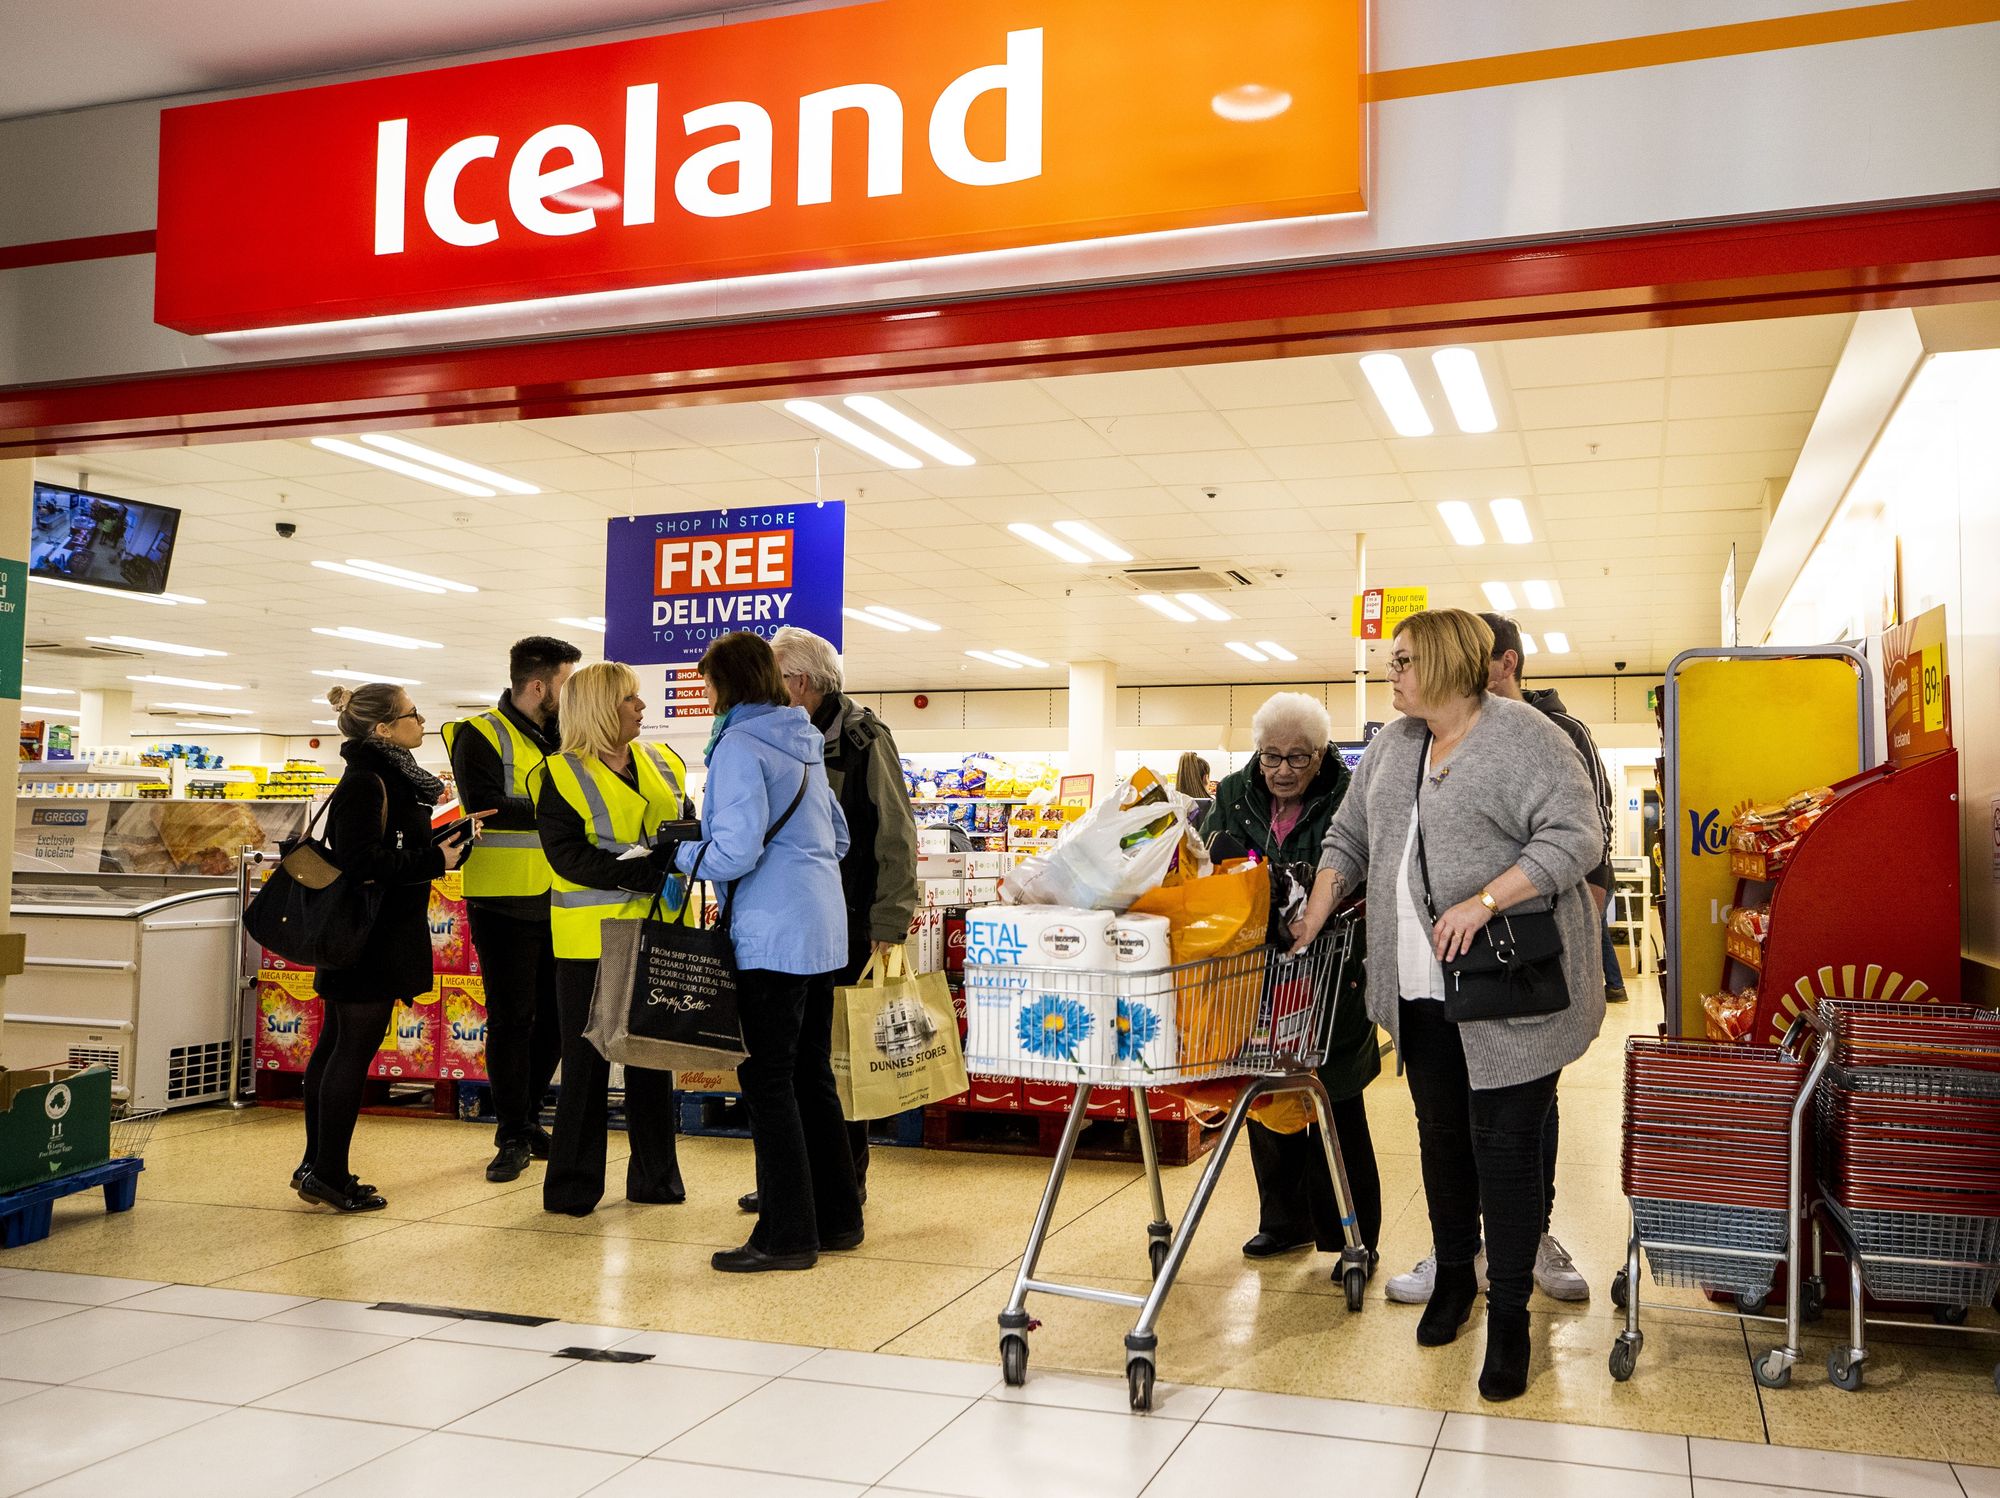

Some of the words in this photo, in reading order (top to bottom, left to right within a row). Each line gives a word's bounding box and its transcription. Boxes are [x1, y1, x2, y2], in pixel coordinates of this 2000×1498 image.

[374, 26, 1044, 256] Iceland
[655, 519, 702, 533] SHOP
[711, 517, 729, 529] IN
[739, 512, 795, 527] STORE
[661, 535, 786, 589] FREE
[1386, 594, 1397, 604] Try
[1409, 594, 1425, 602] new
[652, 593, 793, 626] DELIVERY
[1385, 605, 1408, 615] paper
[653, 630, 675, 642] TO
[685, 627, 731, 641] YOUR
[668, 672, 674, 680] 1
[677, 672, 697, 680] SHOP
[676, 708, 688, 716] WE
[689, 707, 713, 715] DELIVE
[44, 811, 86, 823] GREGGS
[37, 834, 75, 846] Exclusive
[35, 847, 44, 858] to
[44, 846, 75, 858] Iceland
[431, 917, 455, 935] urf
[650, 946, 671, 958] FROM
[671, 951, 687, 960] SHIP
[688, 954, 699, 962] TO
[699, 956, 722, 967] SHORE
[260, 971, 281, 980] MEGA
[281, 972, 300, 981] PACK
[649, 957, 684, 970] ORCHARD
[685, 963, 703, 973] VINE
[704, 966, 715, 975] TO
[714, 969, 731, 979] CORE
[649, 966, 660, 975] WE
[660, 969, 685, 980] SOURCE
[686, 974, 719, 986] NATURAL
[445, 977, 466, 986] MEGA
[648, 976, 659, 985] TO
[660, 979, 678, 989] MAKE
[679, 983, 697, 993] YOUR
[699, 987, 718, 996] FOOD
[647, 988, 679, 1014] Simply
[677, 994, 711, 1012] Better
[267, 1014, 303, 1034] Surf
[399, 1021, 425, 1040] urf
[452, 1021, 489, 1042] Surf
[870, 1056, 915, 1073] DUNNES
[915, 1045, 947, 1064] STORES
[680, 1071, 722, 1089] Kellogg's
